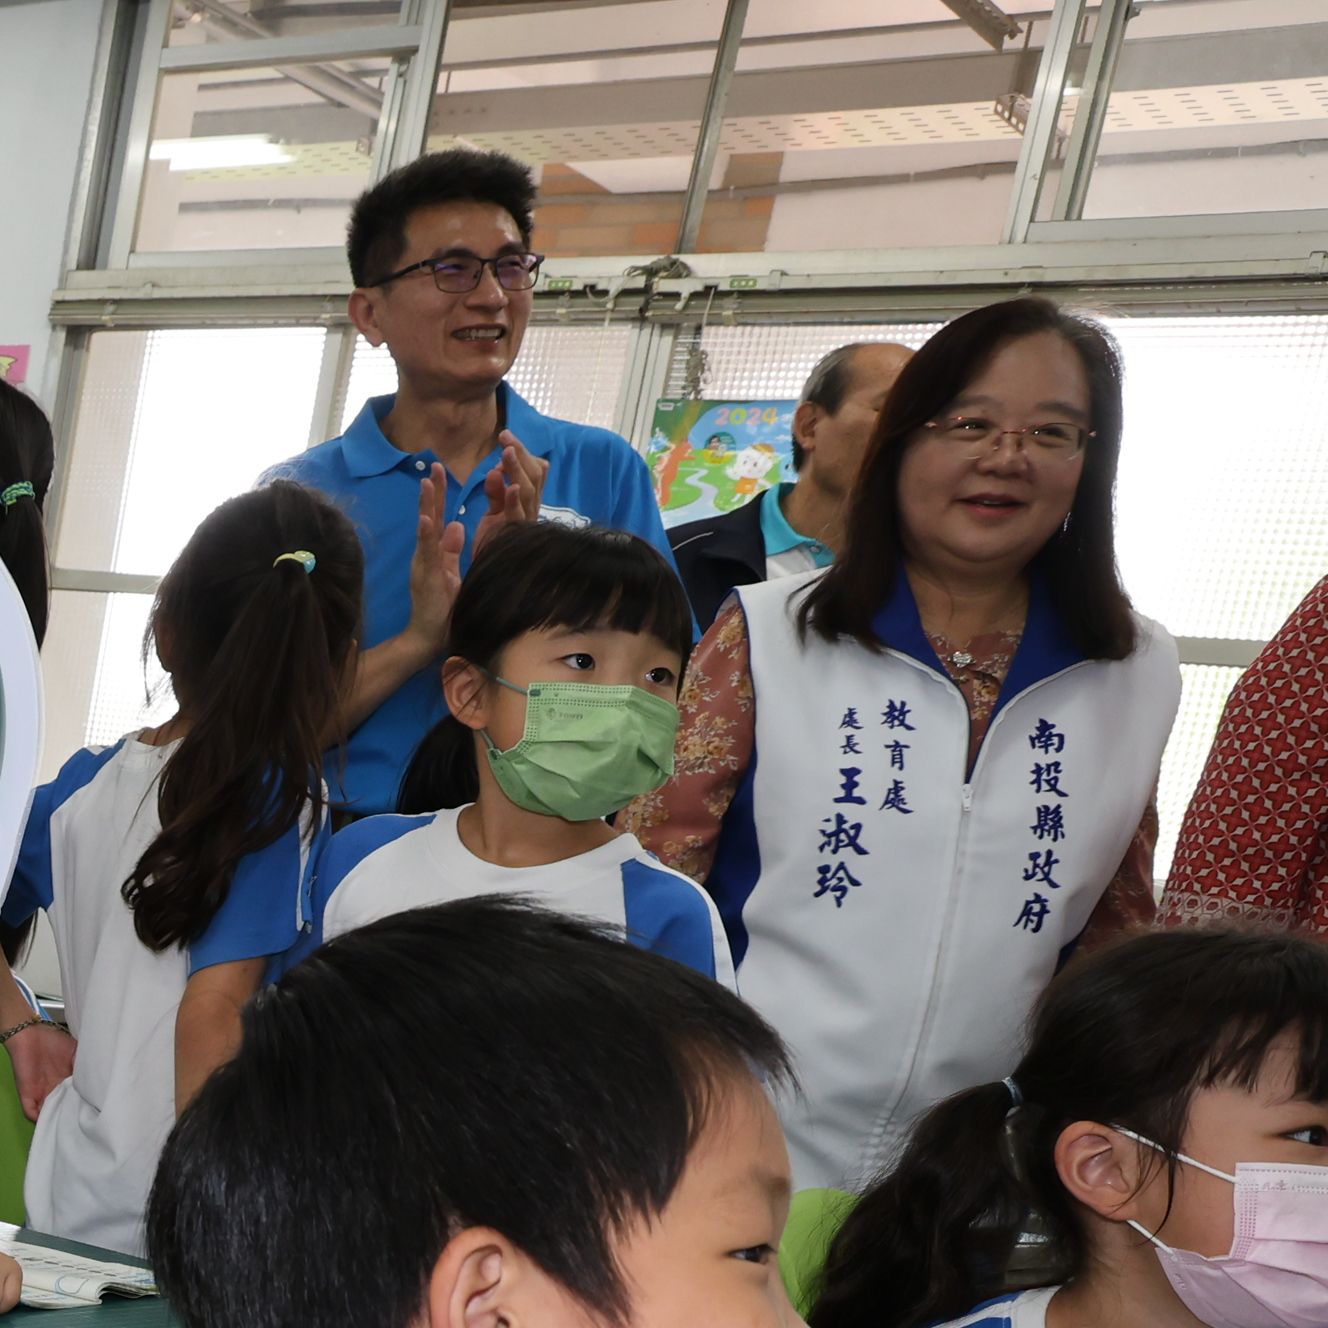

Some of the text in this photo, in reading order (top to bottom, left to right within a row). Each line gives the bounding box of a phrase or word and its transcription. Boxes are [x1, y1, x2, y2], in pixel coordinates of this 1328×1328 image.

[714, 407, 778, 427] 2024
[878, 698, 916, 815] 教育處
[1012, 718, 1070, 934] 南投縣政府
